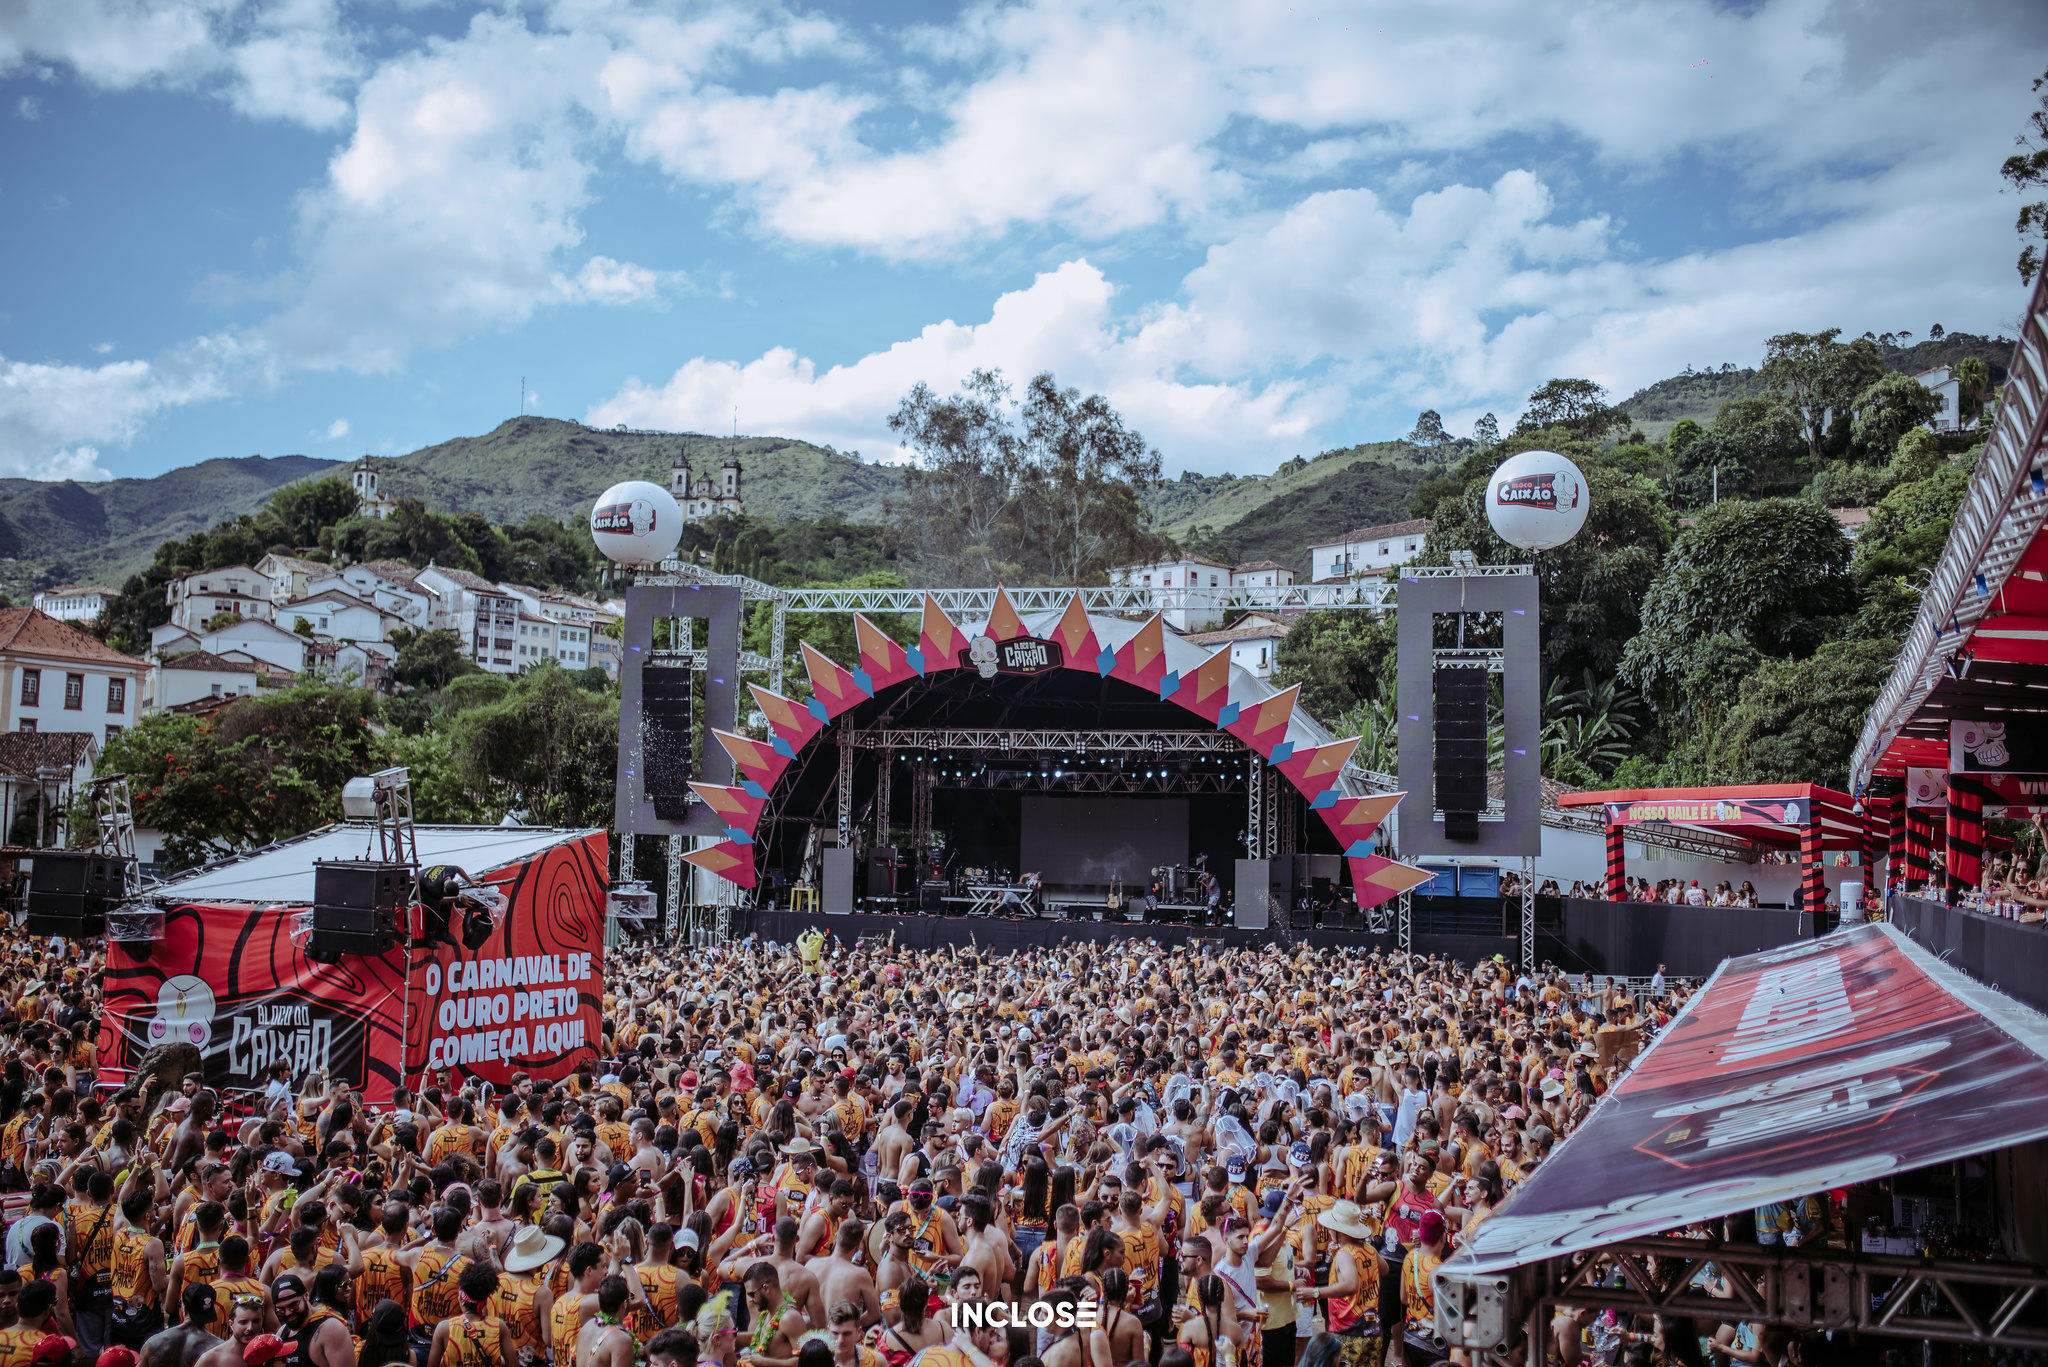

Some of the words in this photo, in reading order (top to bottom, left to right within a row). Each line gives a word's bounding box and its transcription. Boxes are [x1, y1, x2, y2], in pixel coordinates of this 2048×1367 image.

[1500, 485, 1551, 501] CAIXÃO
[1005, 645, 1048, 667] CAIXÃO
[1629, 806, 1666, 820] NOSSO
[1668, 806, 1699, 820] BAILE
[1700, 803, 1708, 820] É
[1710, 803, 1742, 821] FDA
[426, 963, 441, 996] O
[447, 954, 564, 993] CARNAVAL
[568, 952, 592, 981] DE
[257, 1004, 292, 1027] BLOCO
[293, 1005, 310, 1027] DO
[439, 994, 510, 1031] OURO
[513, 987, 579, 1022] PRETO
[229, 1016, 332, 1082] CAIXÃO
[430, 1027, 529, 1070] COMEÇA
[533, 1019, 585, 1056] AQUI!
[1294, 1151, 1310, 1160] FFF
[1228, 1164, 1242, 1174] FFF
